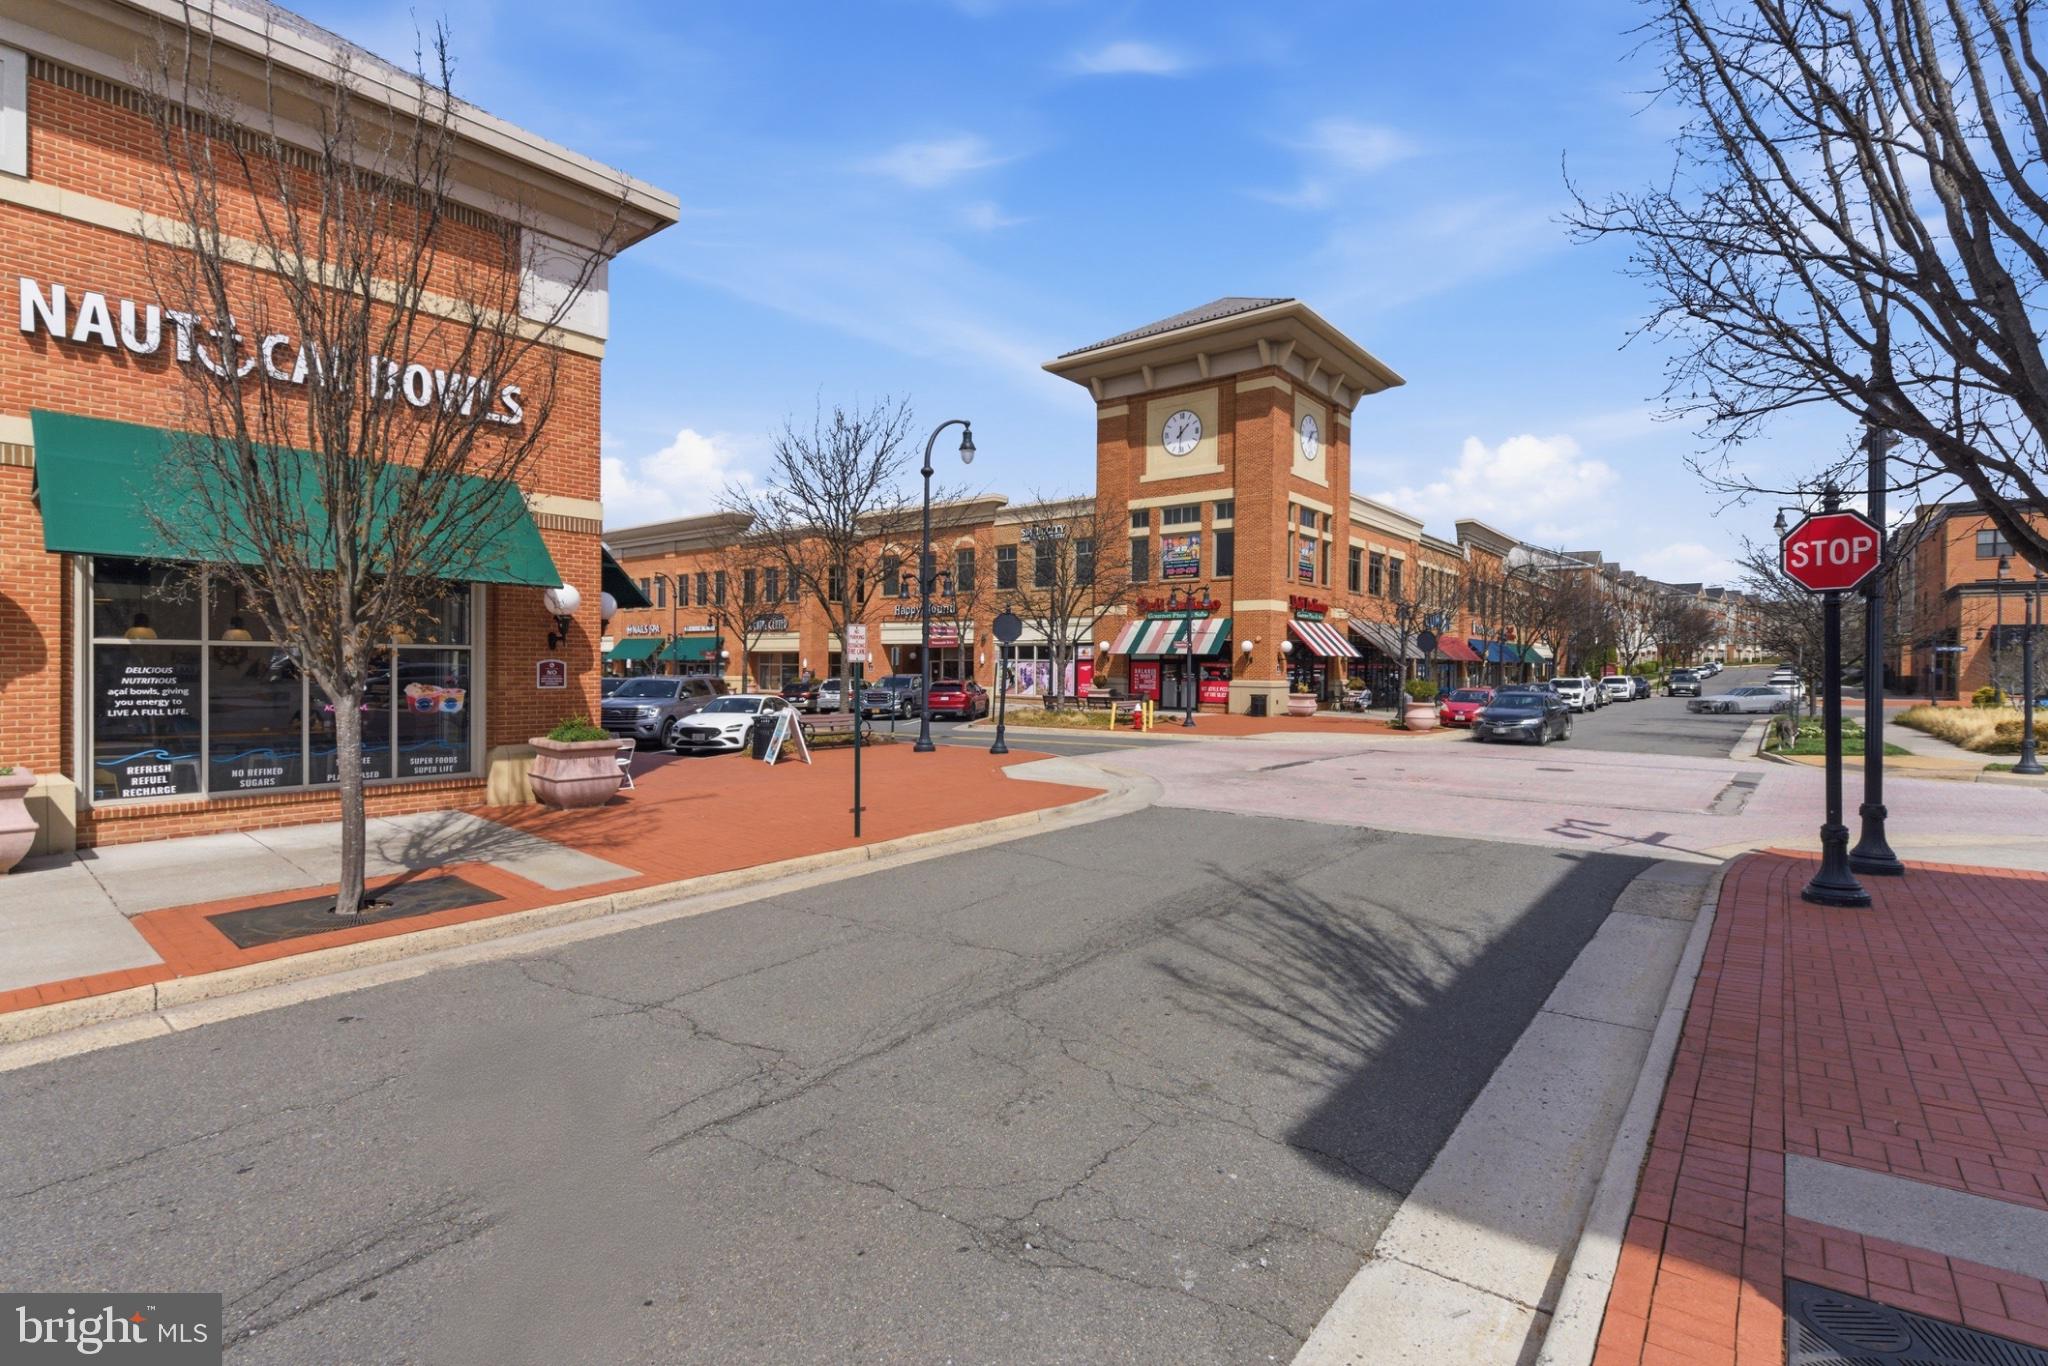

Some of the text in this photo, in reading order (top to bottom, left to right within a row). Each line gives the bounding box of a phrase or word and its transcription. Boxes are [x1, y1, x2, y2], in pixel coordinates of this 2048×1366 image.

[370, 353, 524, 425] BOWLS
[1790, 536, 1873, 568] STOP
[894, 601, 956, 616] Happy ound
[125, 666, 174, 674] DELICIOUS
[121, 677, 177, 685] NUTRITIOUS
[130, 687, 160, 696] bowls,
[162, 687, 190, 697] giving
[114, 700, 134, 708] you
[136, 699, 170, 708] energy
[107, 709, 129, 717] LIVE
[141, 708, 165, 716] FULL
[410, 756, 458, 765] SUPER FOODS
[126, 764, 172, 775] REFRESH
[231, 767, 284, 778] NO REFINED
[414, 764, 454, 774] SUPER LIFE
[131, 775, 168, 786] REFUEL
[239, 777, 276, 788] SUGARS
[122, 785, 177, 798] RECHARGE
